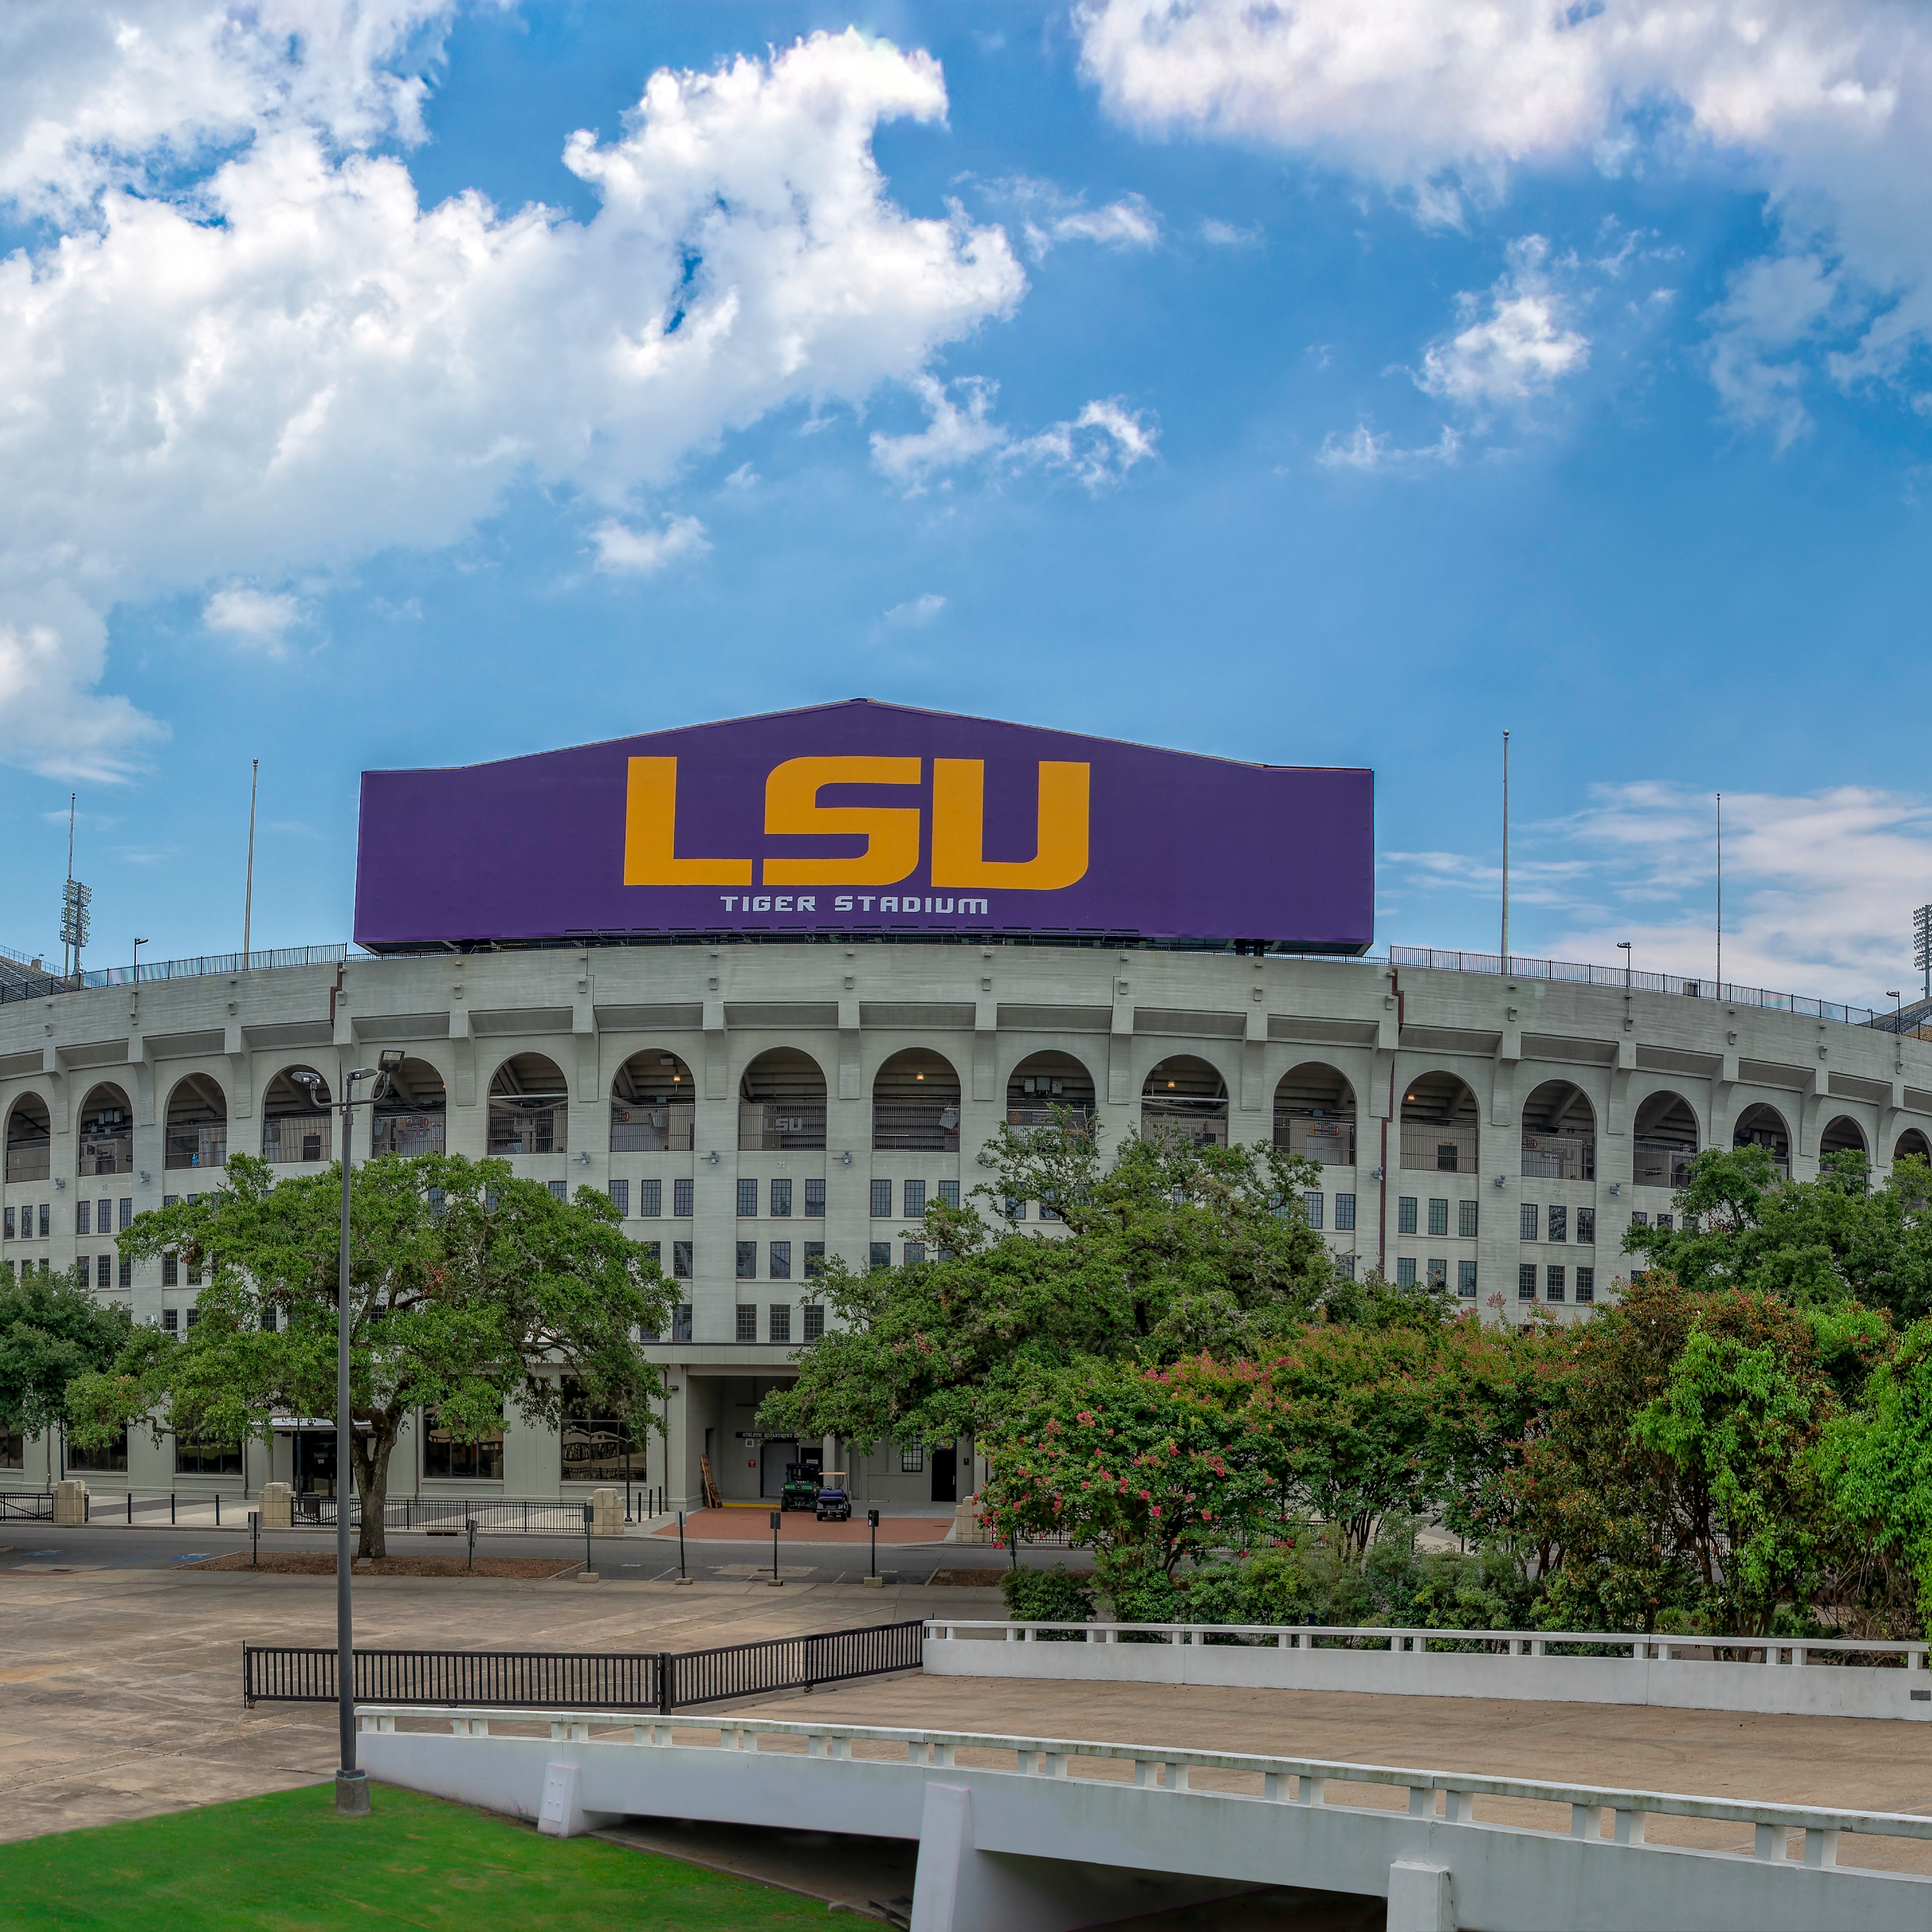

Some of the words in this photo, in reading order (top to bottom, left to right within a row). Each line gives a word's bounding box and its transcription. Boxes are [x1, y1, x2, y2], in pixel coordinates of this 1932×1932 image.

[624, 756, 1089, 890] LSU
[721, 896, 815, 911] TIGER
[835, 896, 987, 914] STADIUM
[763, 1118, 802, 1131] LSU
